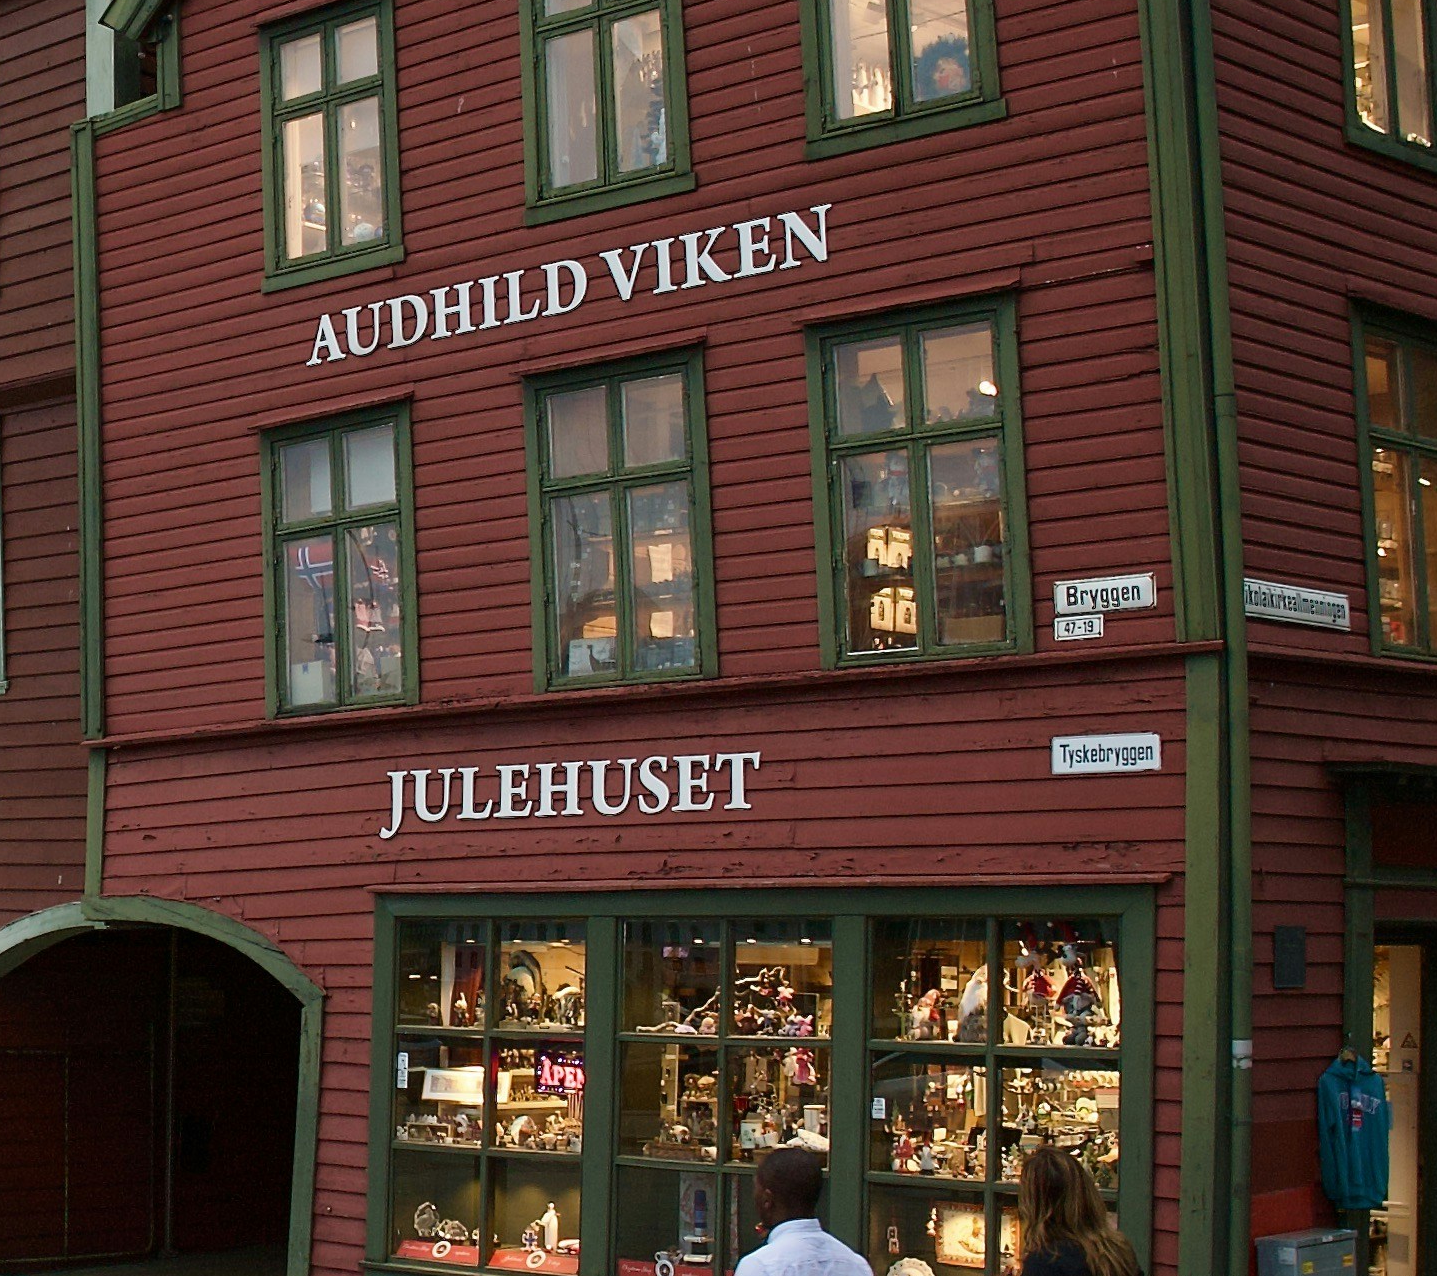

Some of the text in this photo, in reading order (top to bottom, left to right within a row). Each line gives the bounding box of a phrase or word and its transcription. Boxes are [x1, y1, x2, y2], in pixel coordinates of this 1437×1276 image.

[305, 204, 834, 368] AUDHILD VIKEN
[1066, 582, 1141, 610] Bryggen
[1063, 620, 1095, 635] 47-19
[1059, 742, 1154, 769] Tyskebryggen
[379, 752, 761, 840] JULEHUSET
